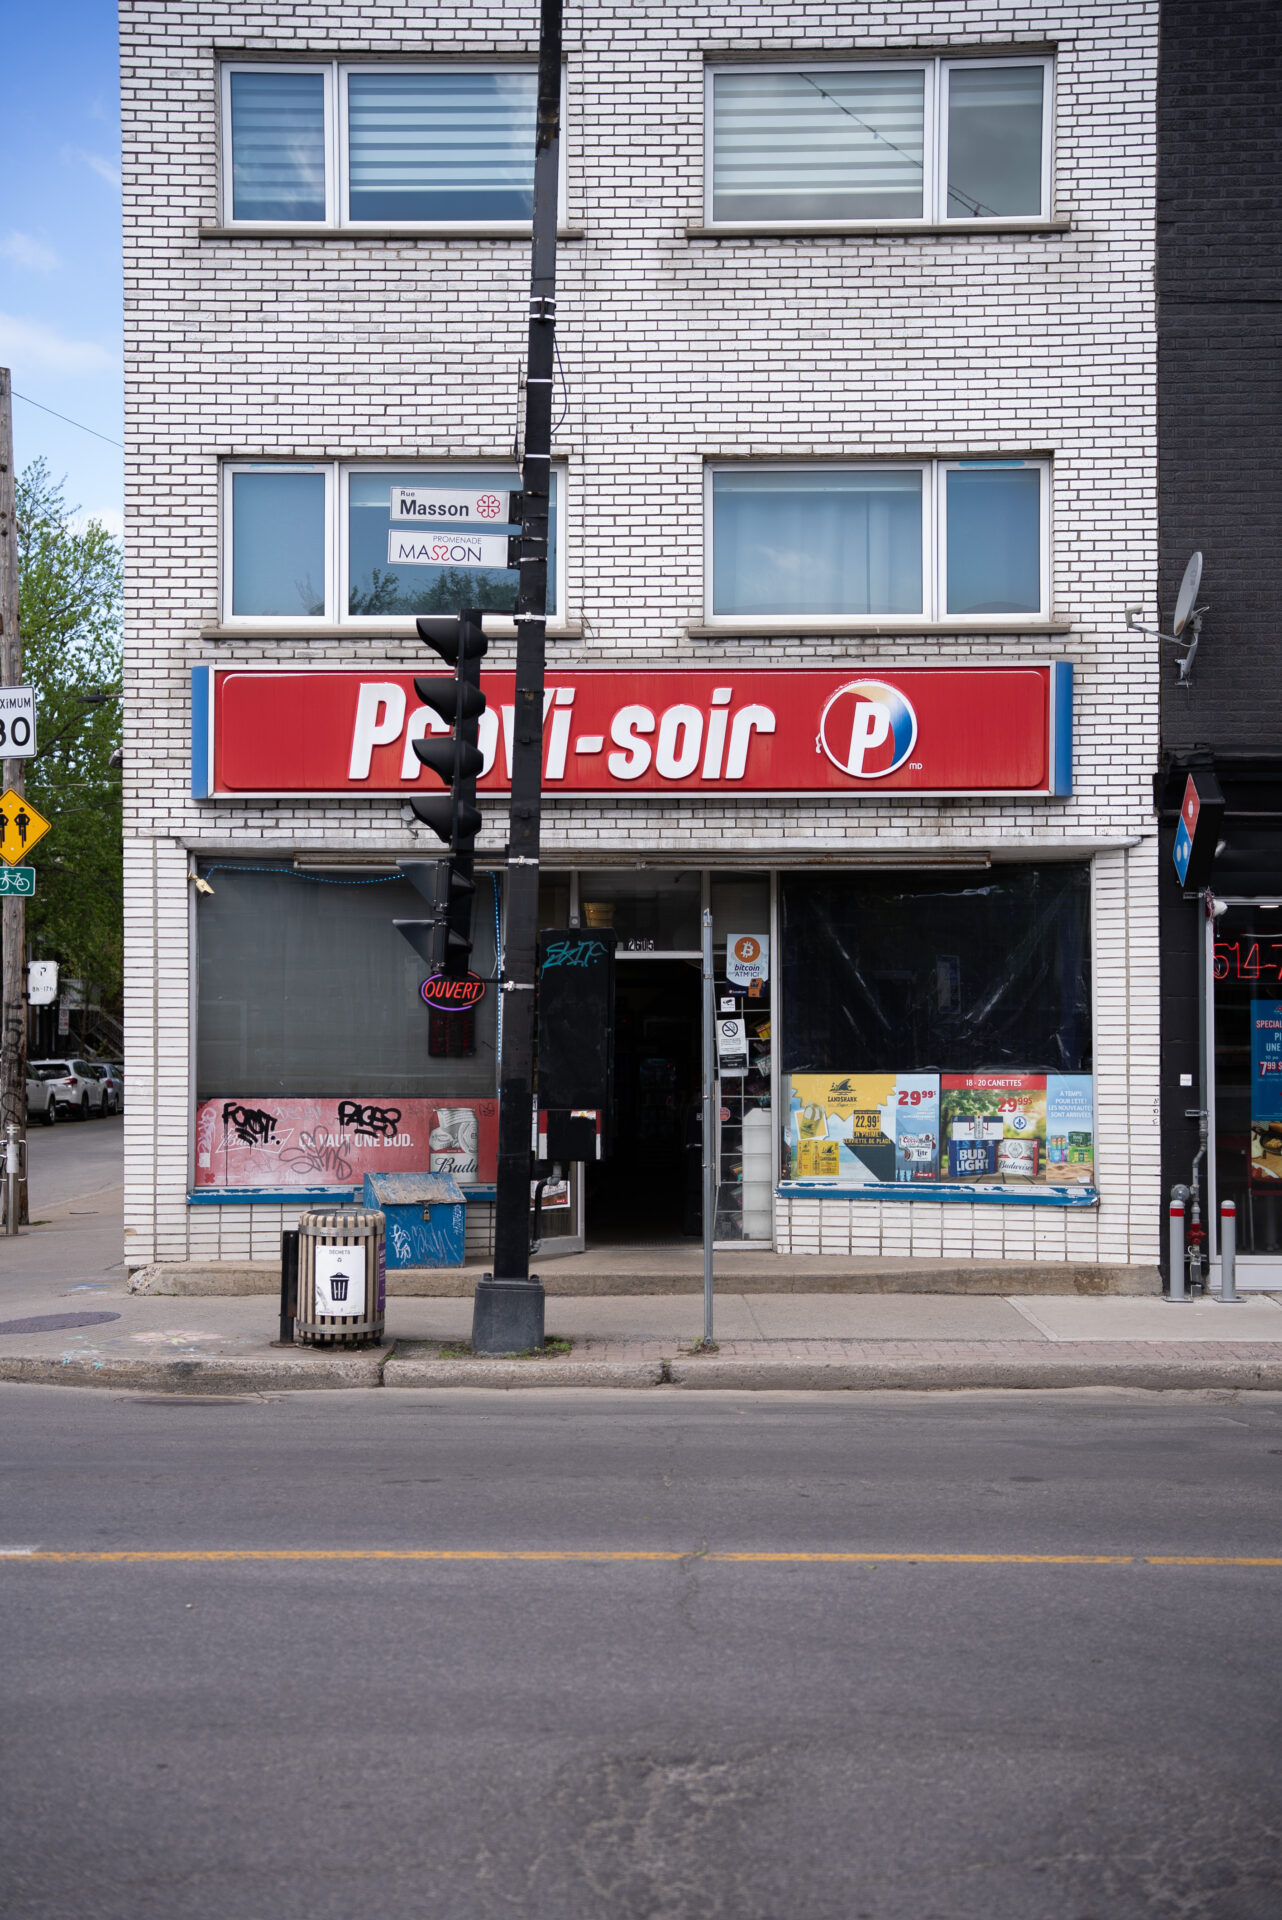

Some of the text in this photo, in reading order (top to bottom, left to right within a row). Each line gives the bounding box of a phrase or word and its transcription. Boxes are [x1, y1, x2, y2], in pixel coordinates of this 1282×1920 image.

[400, 499, 469, 517] Masson
[432, 535, 482, 545] PROMENADE
[399, 544, 482, 562] MASSON
[734, 963, 760, 971] bitcoin
[424, 981, 481, 999] OUVERT
[1266, 1043, 1281, 1052] UNE
[966, 1079, 973, 1087] 18
[318, 1133, 352, 1147] VAUT
[354, 1133, 381, 1147] UNE
[384, 1133, 414, 1147] BUD.
[960, 1149, 987, 1160] BUD
[956, 1159, 989, 1171] LIGHT
[999, 1160, 1034, 1170] Budweiser
